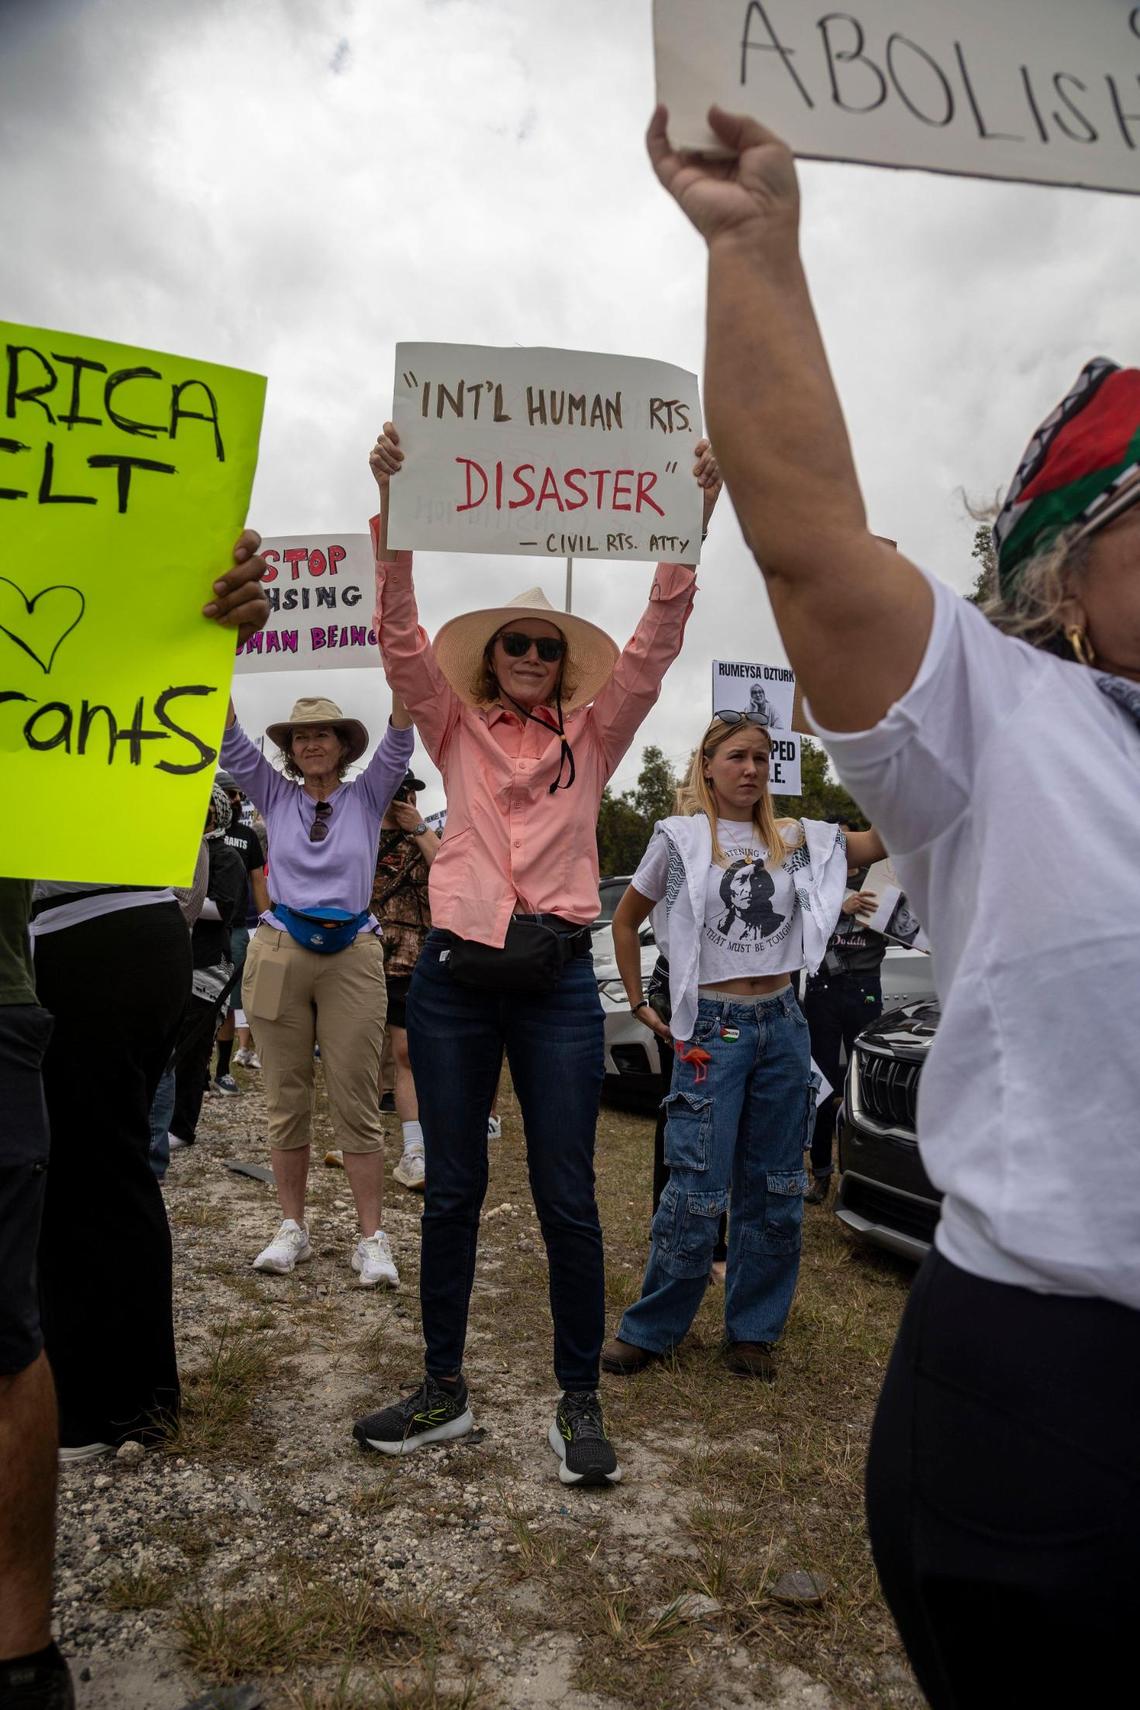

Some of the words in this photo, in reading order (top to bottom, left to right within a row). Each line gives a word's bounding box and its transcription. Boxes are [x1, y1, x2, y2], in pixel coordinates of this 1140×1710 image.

[7, 345, 225, 461] RICA
[526, 386, 623, 431] HUMAN
[649, 397, 692, 434] RTS.
[546, 534, 599, 553] CIVIL
[606, 534, 638, 551] RTS.
[258, 545, 347, 583] STOP
[236, 630, 299, 656] MAN
[718, 663, 761, 679] RUMEYSA
[763, 667, 795, 683] OZTURK
[706, 927, 727, 947] THAT
[727, 941, 752, 953] MUST
[754, 942, 765, 953] BE
[766, 922, 792, 947] TOUGH
